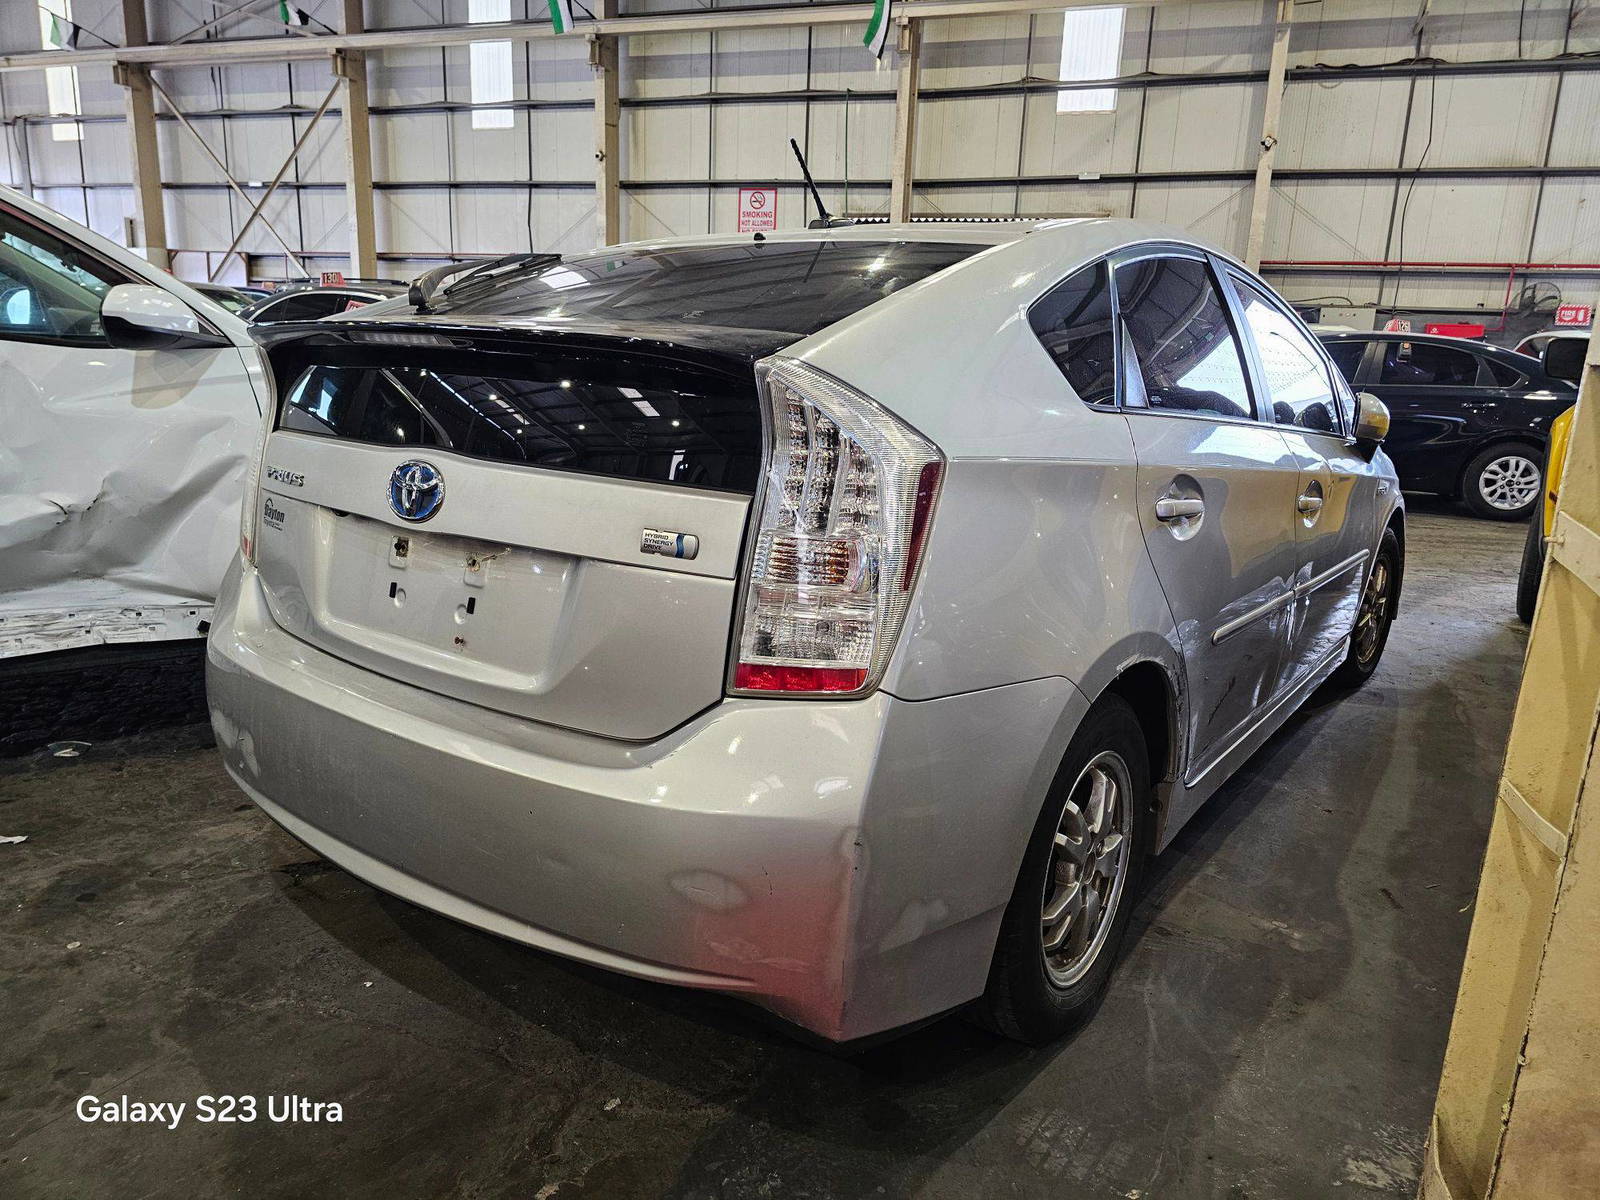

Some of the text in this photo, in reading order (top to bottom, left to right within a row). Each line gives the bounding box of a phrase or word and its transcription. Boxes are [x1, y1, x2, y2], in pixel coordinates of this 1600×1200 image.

[742, 210, 773, 218] SMOKING
[752, 219, 773, 227] ALLOWED
[322, 272, 338, 284] 130
[267, 465, 305, 487] PRIUS
[643, 537, 674, 547] SYNERGY
[643, 543, 662, 551] DRIVE
